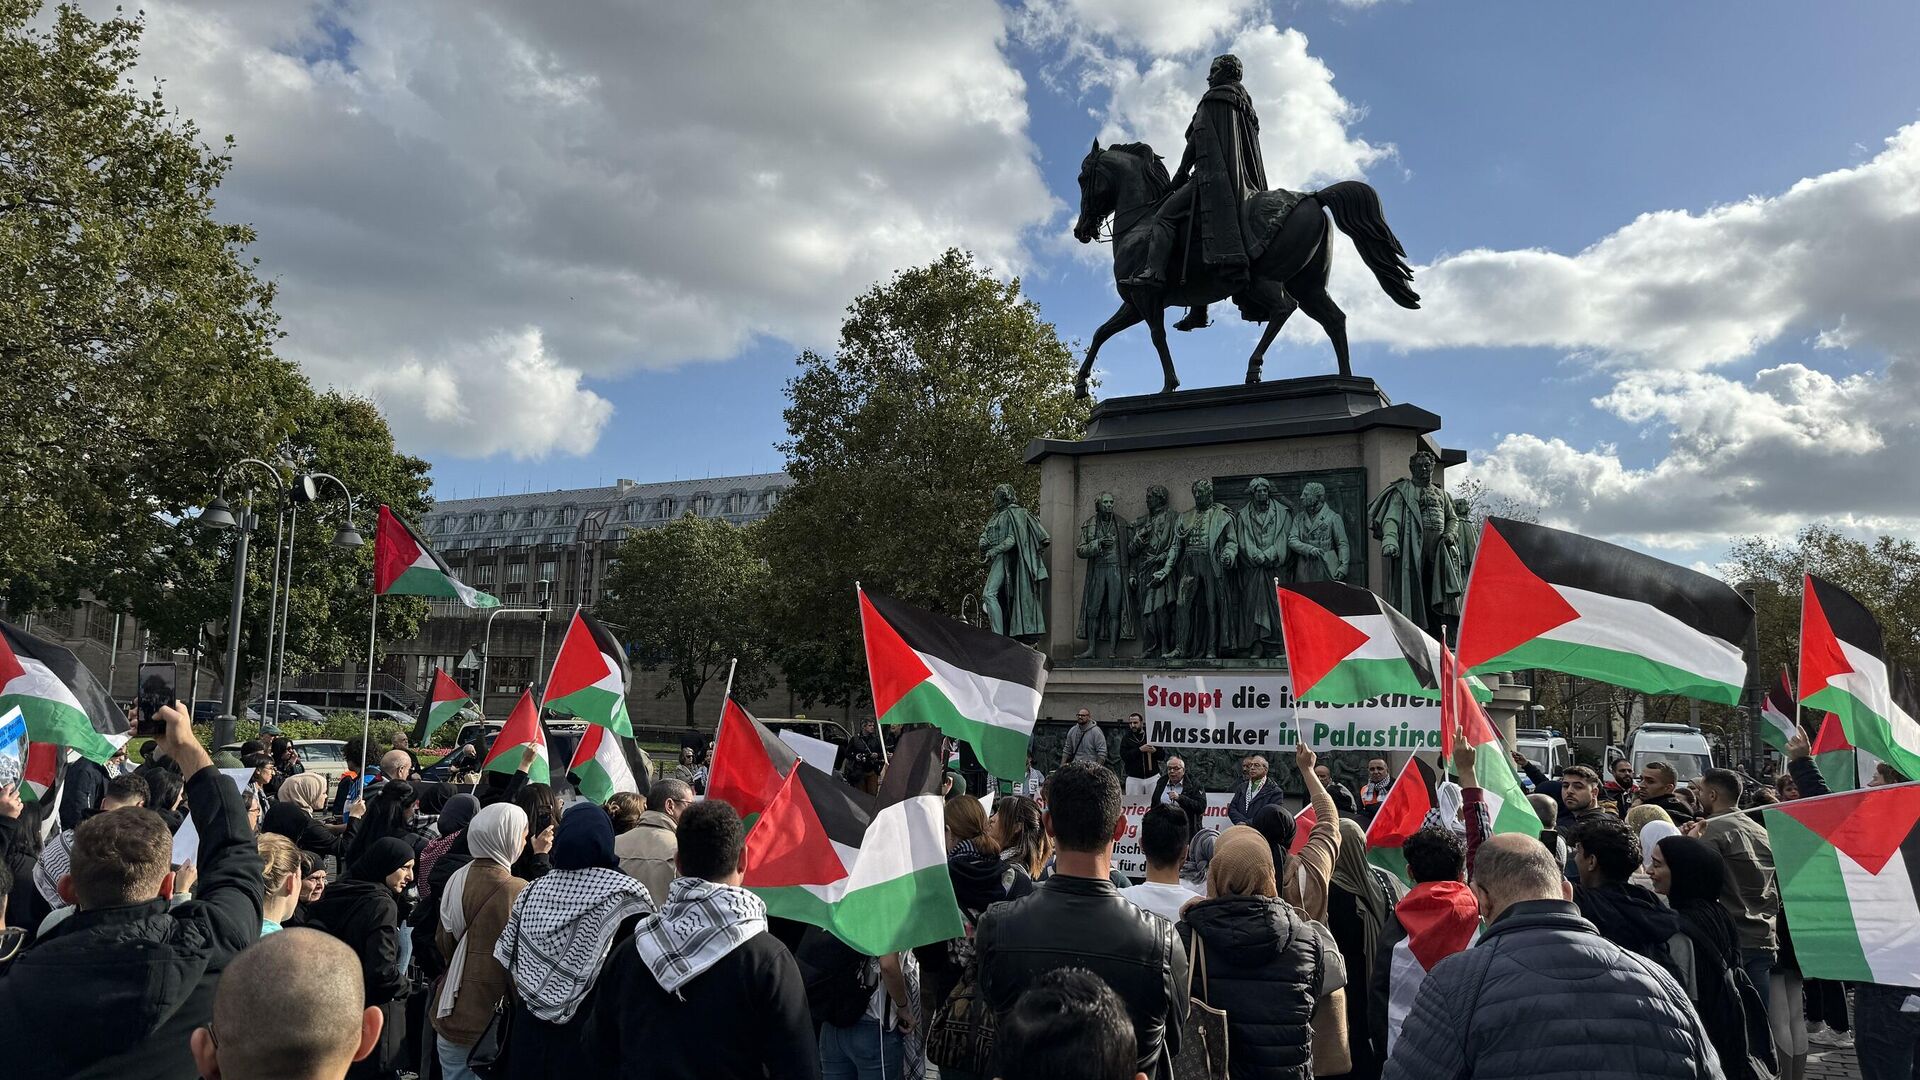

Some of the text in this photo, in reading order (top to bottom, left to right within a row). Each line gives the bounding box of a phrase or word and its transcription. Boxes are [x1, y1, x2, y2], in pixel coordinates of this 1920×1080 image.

[1147, 685, 1222, 713] Stoppt
[1232, 686, 1270, 708] die
[1151, 721, 1442, 747] Massaker in Palastina
[1112, 841, 1145, 855] lisch
[1120, 860, 1136, 872] für
